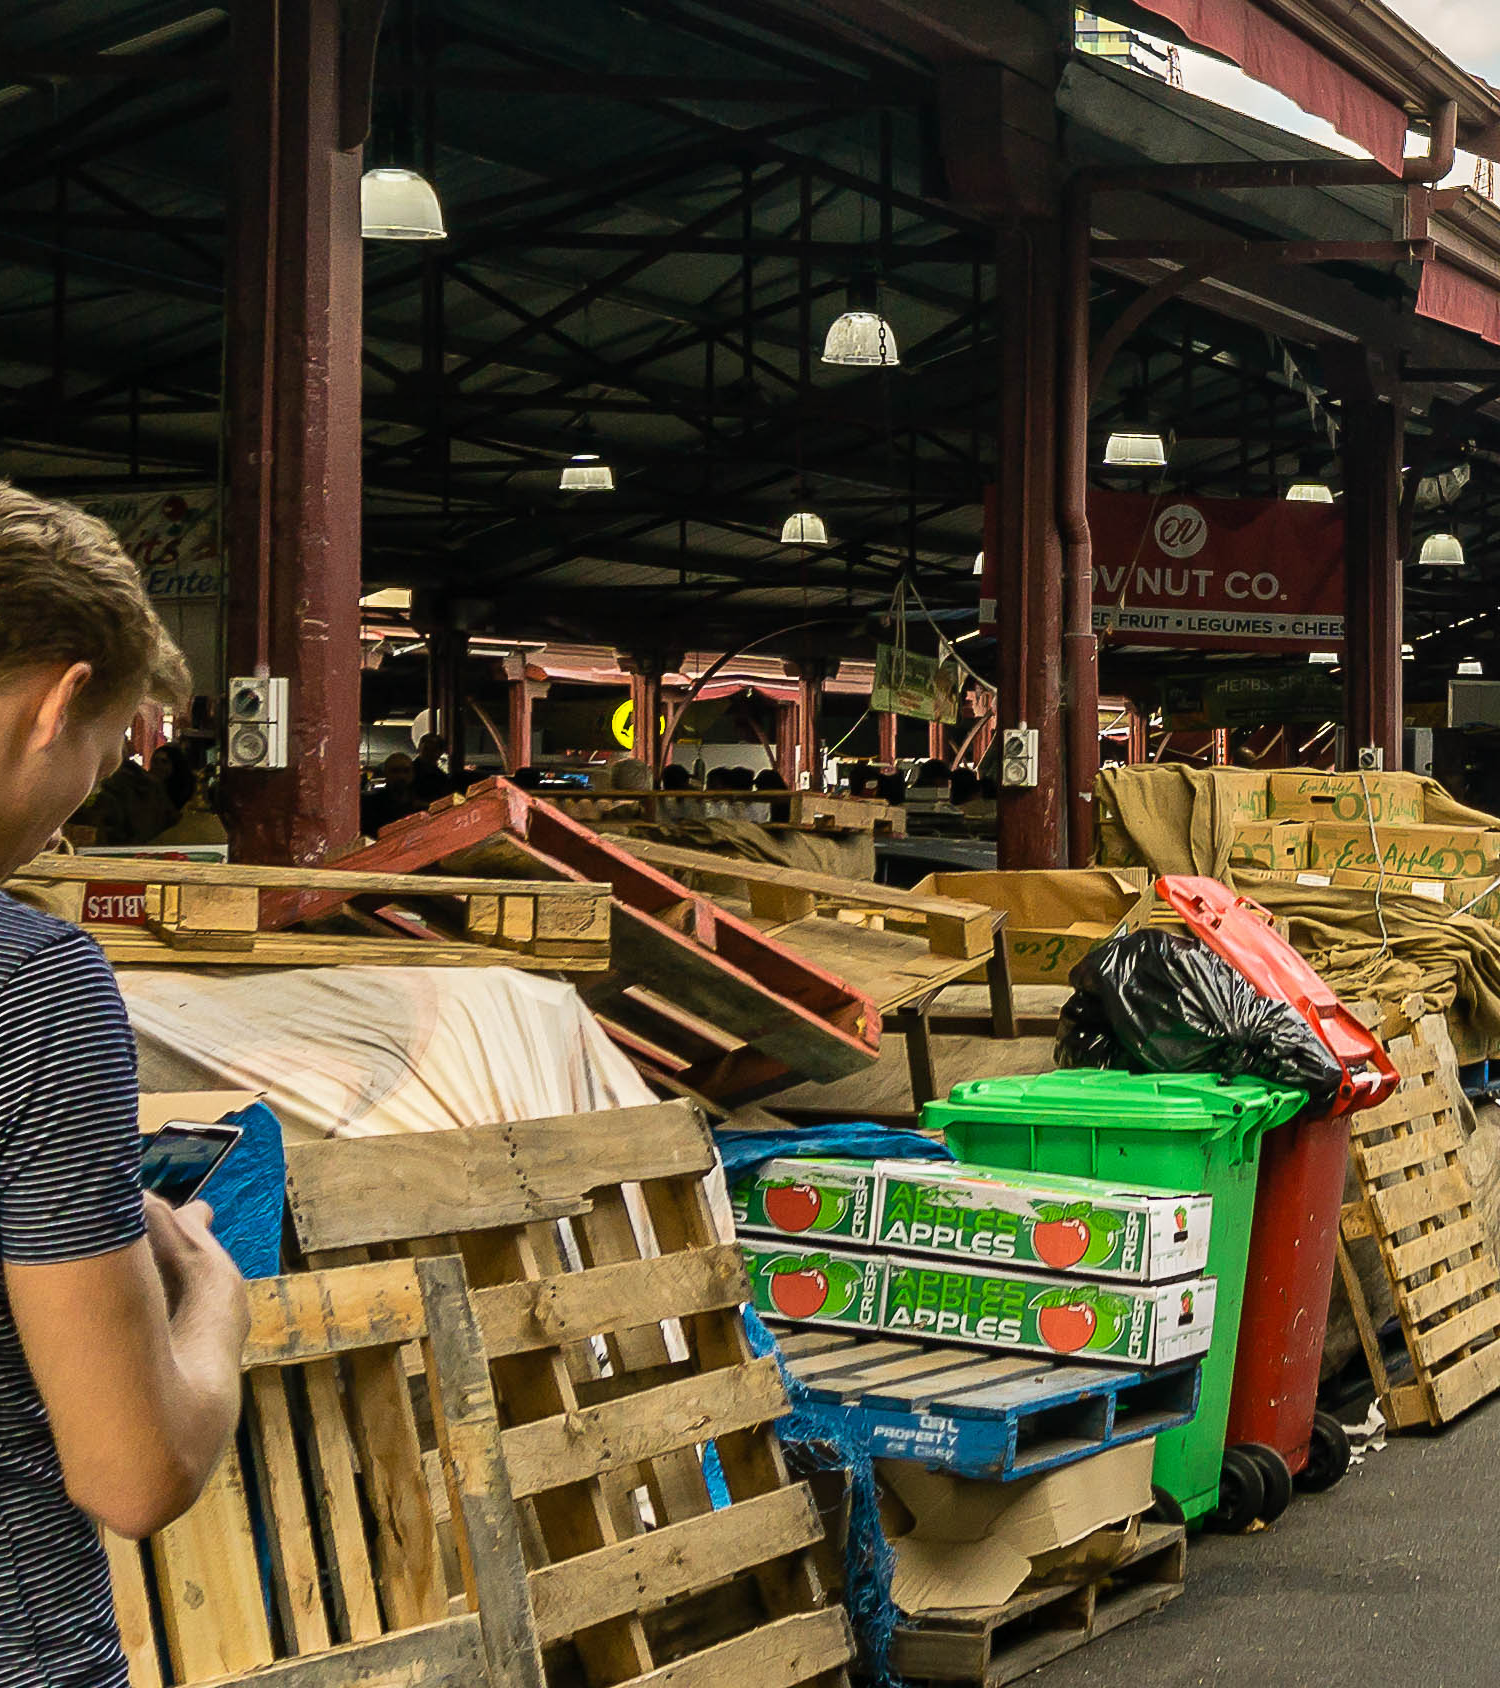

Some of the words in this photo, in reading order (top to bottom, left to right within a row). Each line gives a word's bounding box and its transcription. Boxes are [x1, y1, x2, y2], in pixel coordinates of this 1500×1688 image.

[1137, 566, 1214, 598] NUT
[1224, 570, 1288, 602] CO.
[1118, 614, 1169, 631] FRUIT
[1187, 616, 1273, 634] LEGUMES
[1336, 838, 1383, 870] Eco
[851, 1175, 870, 1239] CRISP
[1120, 1211, 1141, 1274] CRISP
[884, 1219, 1017, 1259] APPLES
[858, 1261, 878, 1326] CRISP
[1127, 1294, 1147, 1360] CRISP
[887, 1306, 1022, 1344] APPLES
[873, 1424, 958, 1447] PROPERTY
